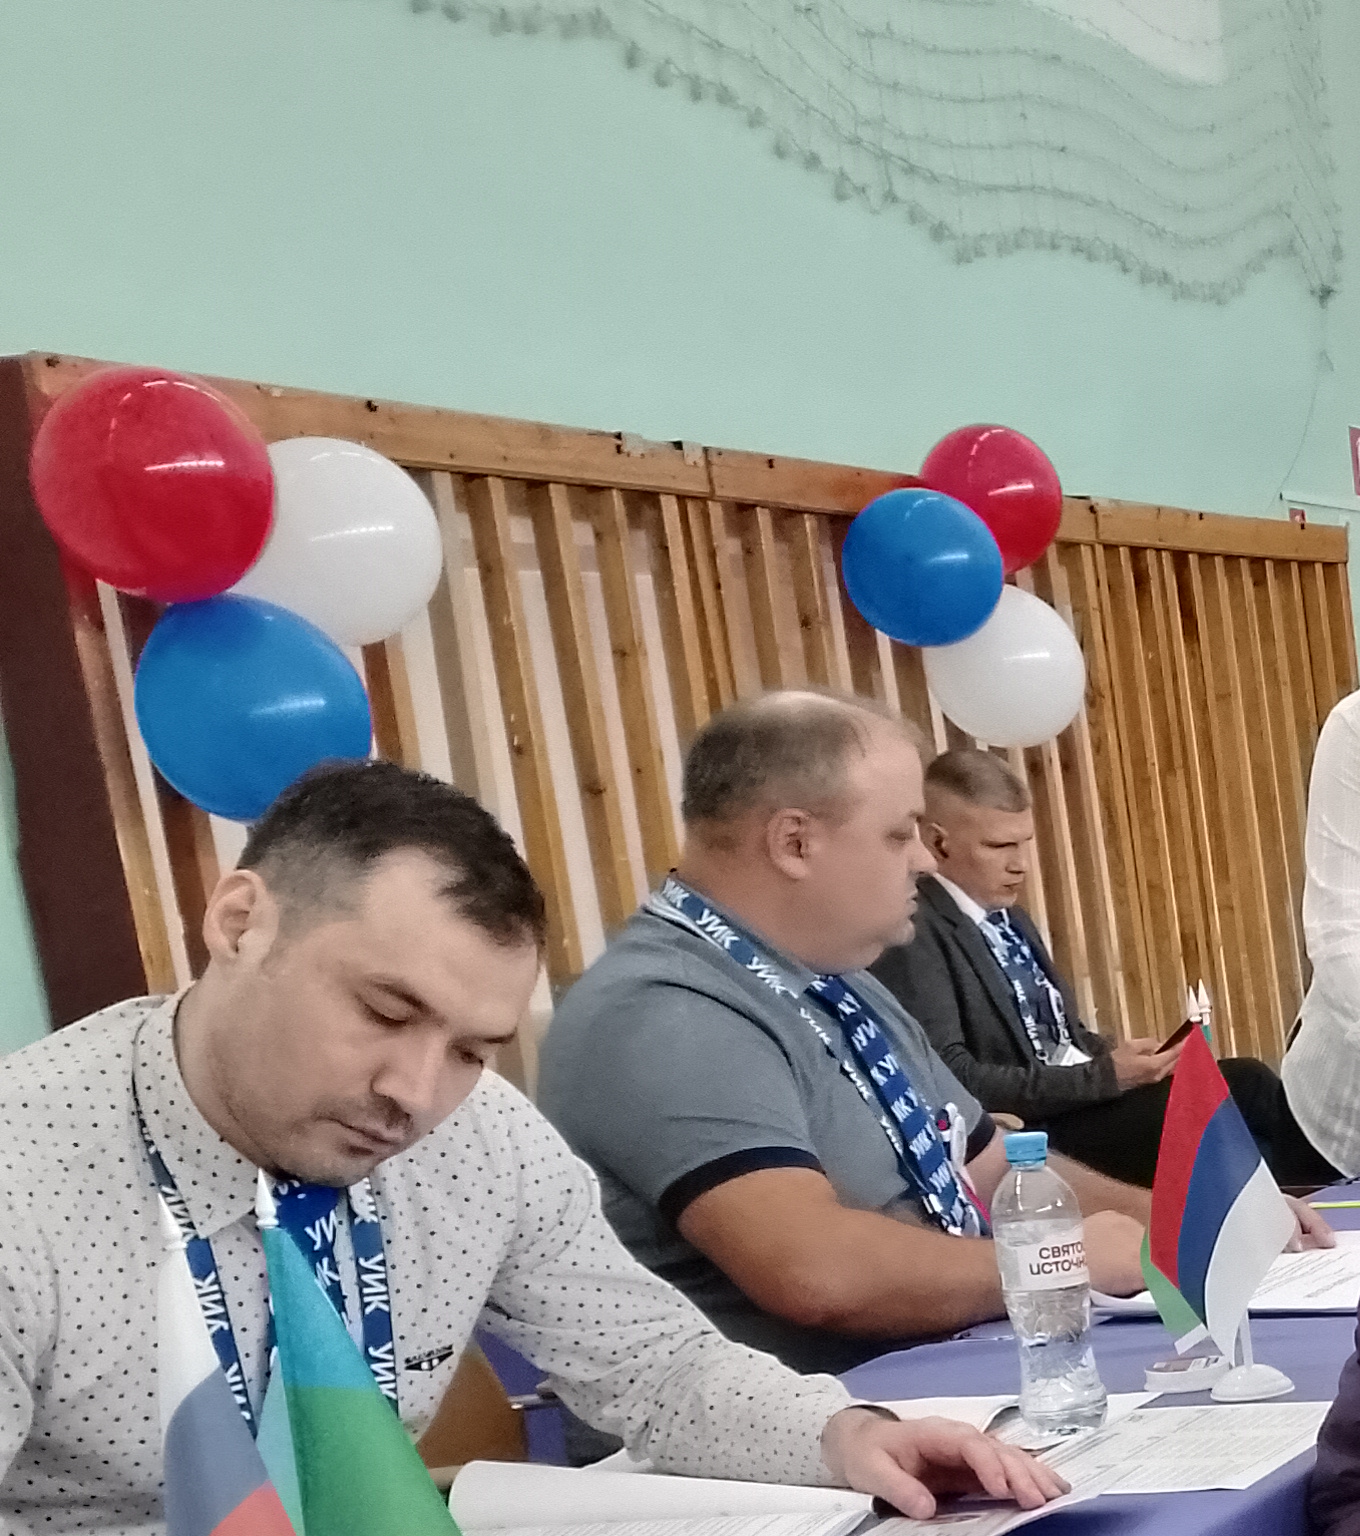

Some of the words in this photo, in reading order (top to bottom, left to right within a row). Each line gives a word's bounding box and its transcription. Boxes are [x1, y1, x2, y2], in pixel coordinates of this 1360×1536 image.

[696, 907, 740, 950] УИК
[1039, 1241, 1085, 1259] СВЯТО
[194, 1270, 229, 1335] УИК
[359, 1253, 390, 1315] УИК
